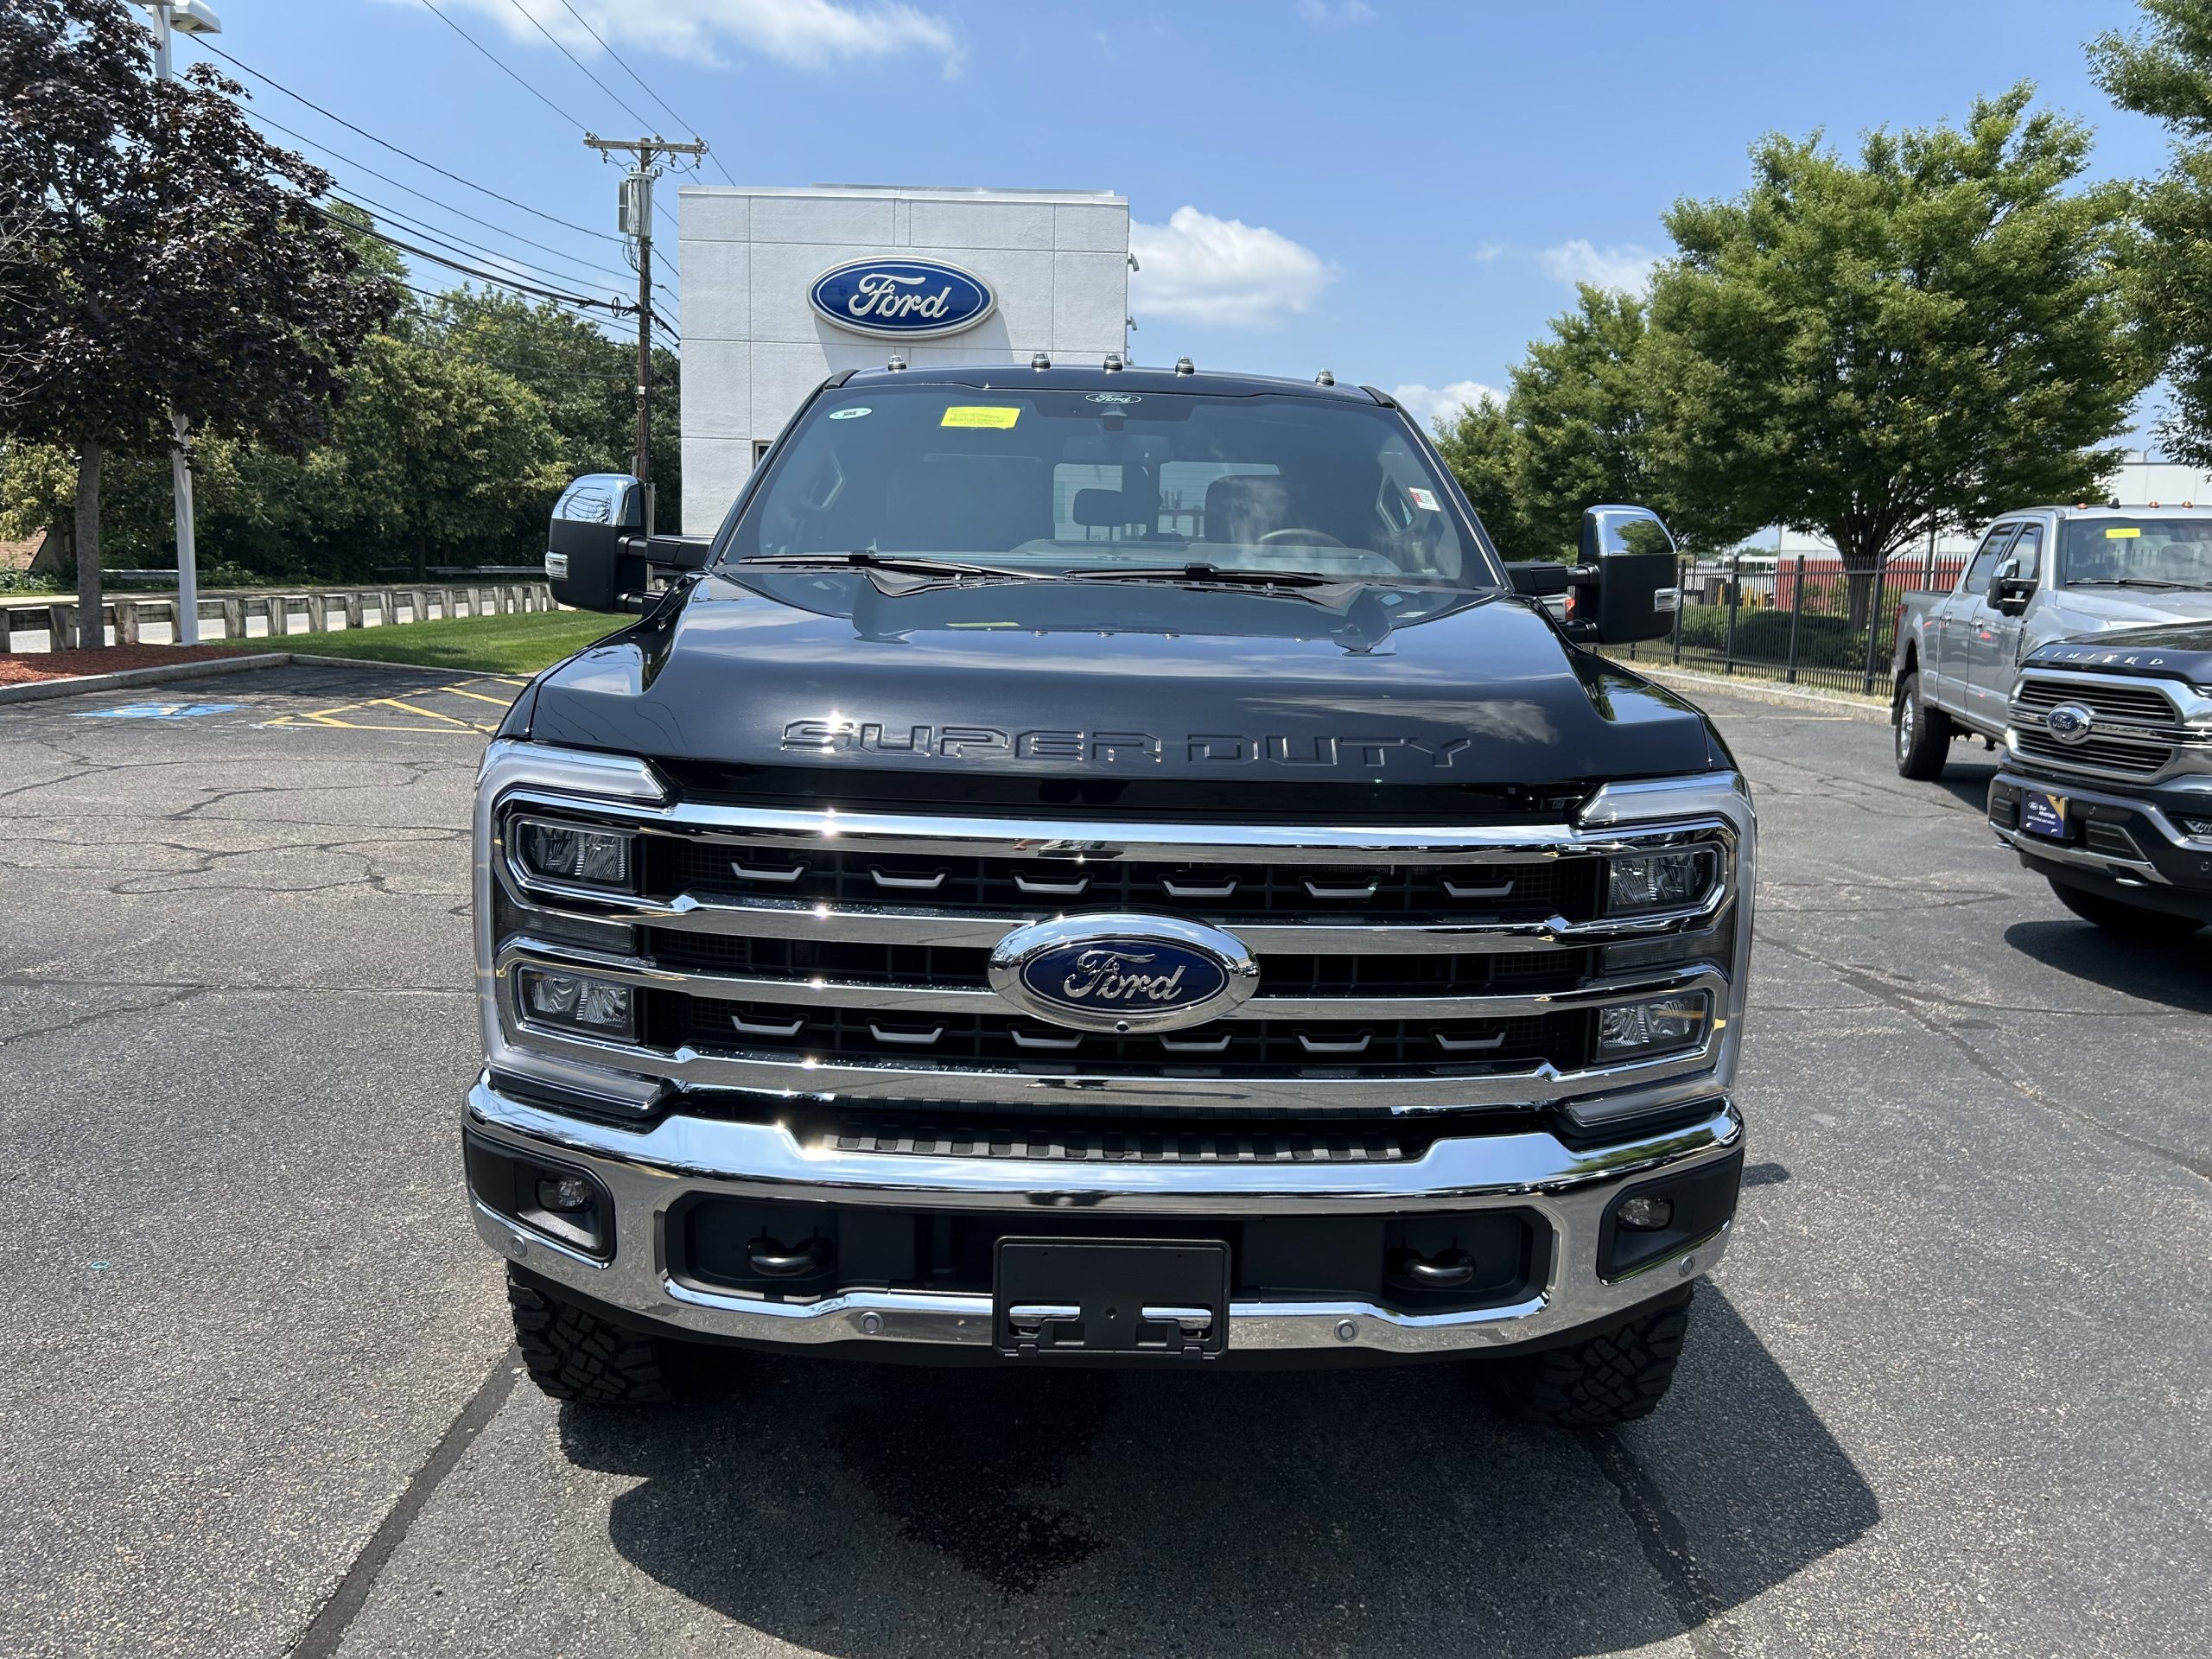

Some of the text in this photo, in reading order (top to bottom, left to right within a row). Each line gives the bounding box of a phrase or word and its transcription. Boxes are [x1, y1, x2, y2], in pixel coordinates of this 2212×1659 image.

[849, 273, 951, 318] Ford
[1095, 394, 1131, 403] Ford
[2039, 651, 2164, 665] LIMITED
[2052, 714, 2073, 730] Ford
[781, 719, 1472, 769] SUPER DUTY
[1064, 950, 1185, 1000] Ford
